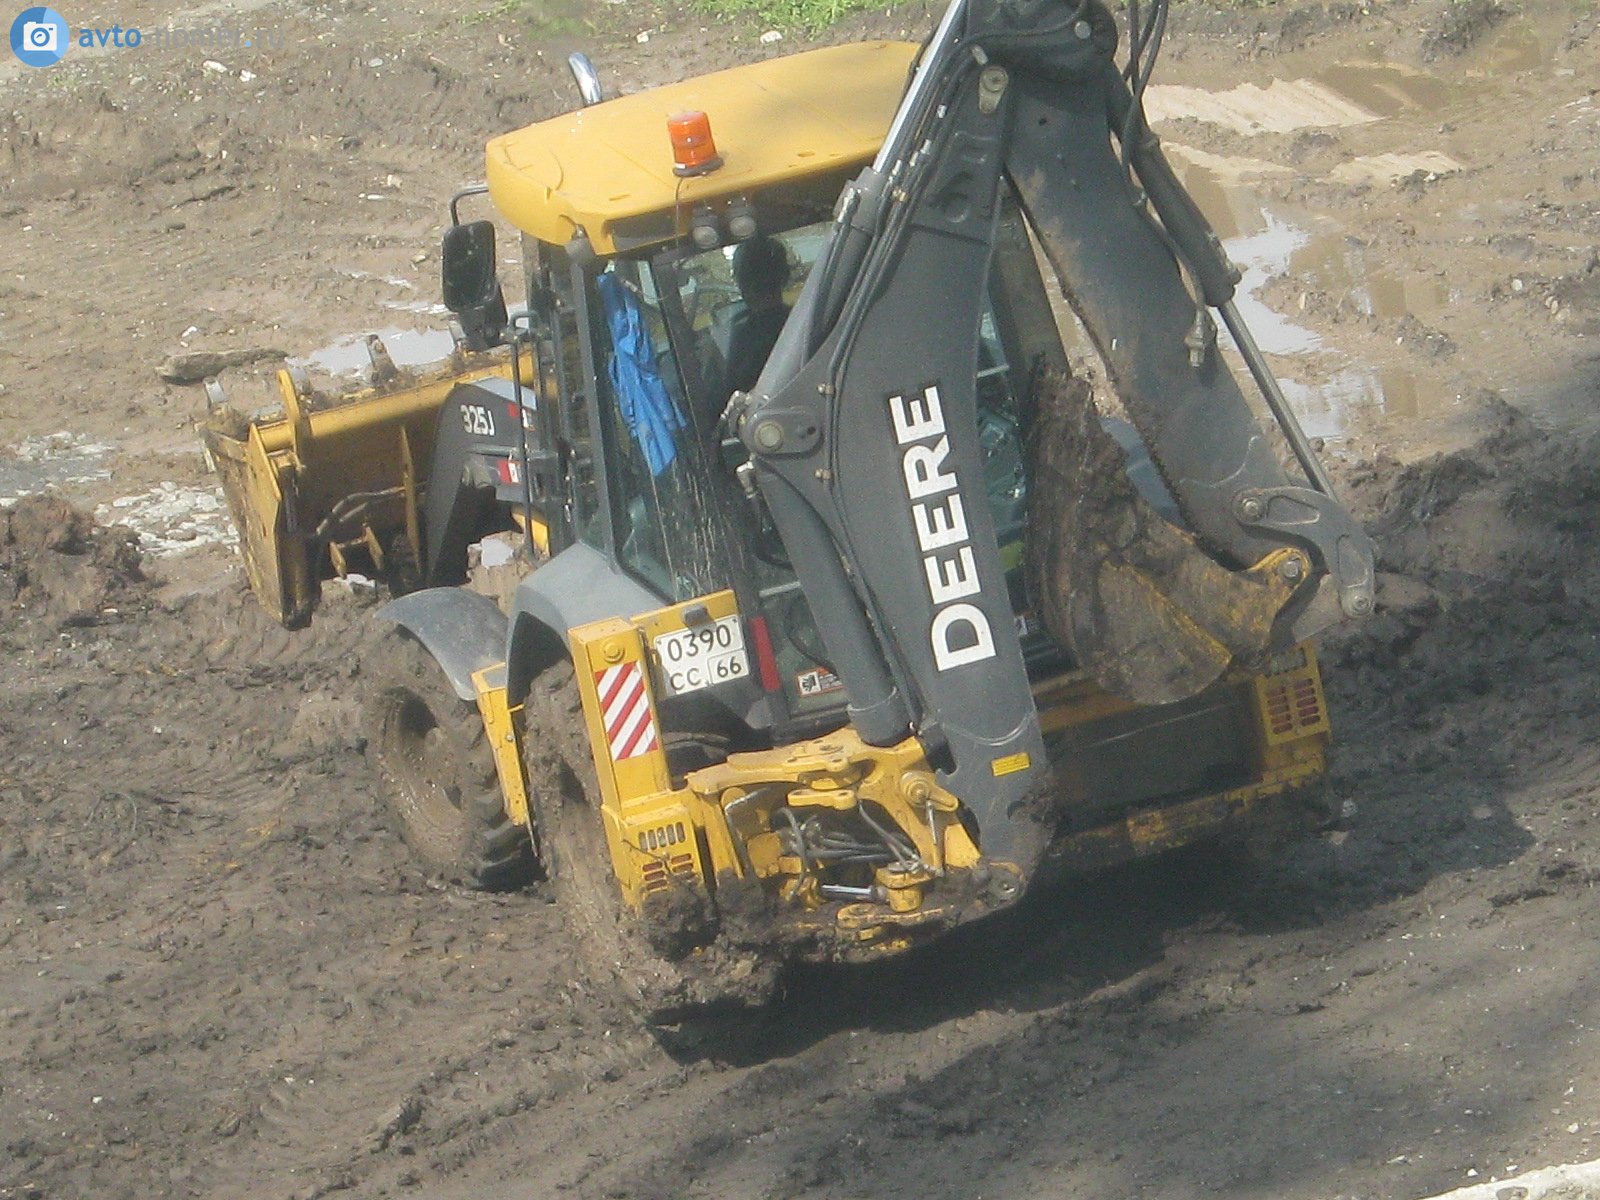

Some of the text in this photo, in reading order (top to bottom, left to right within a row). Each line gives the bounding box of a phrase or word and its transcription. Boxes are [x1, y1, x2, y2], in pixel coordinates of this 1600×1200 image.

[460, 403, 496, 437] 325J
[888, 385, 997, 673] DEERE
[666, 623, 732, 662] 0390
[716, 655, 742, 679] 66
